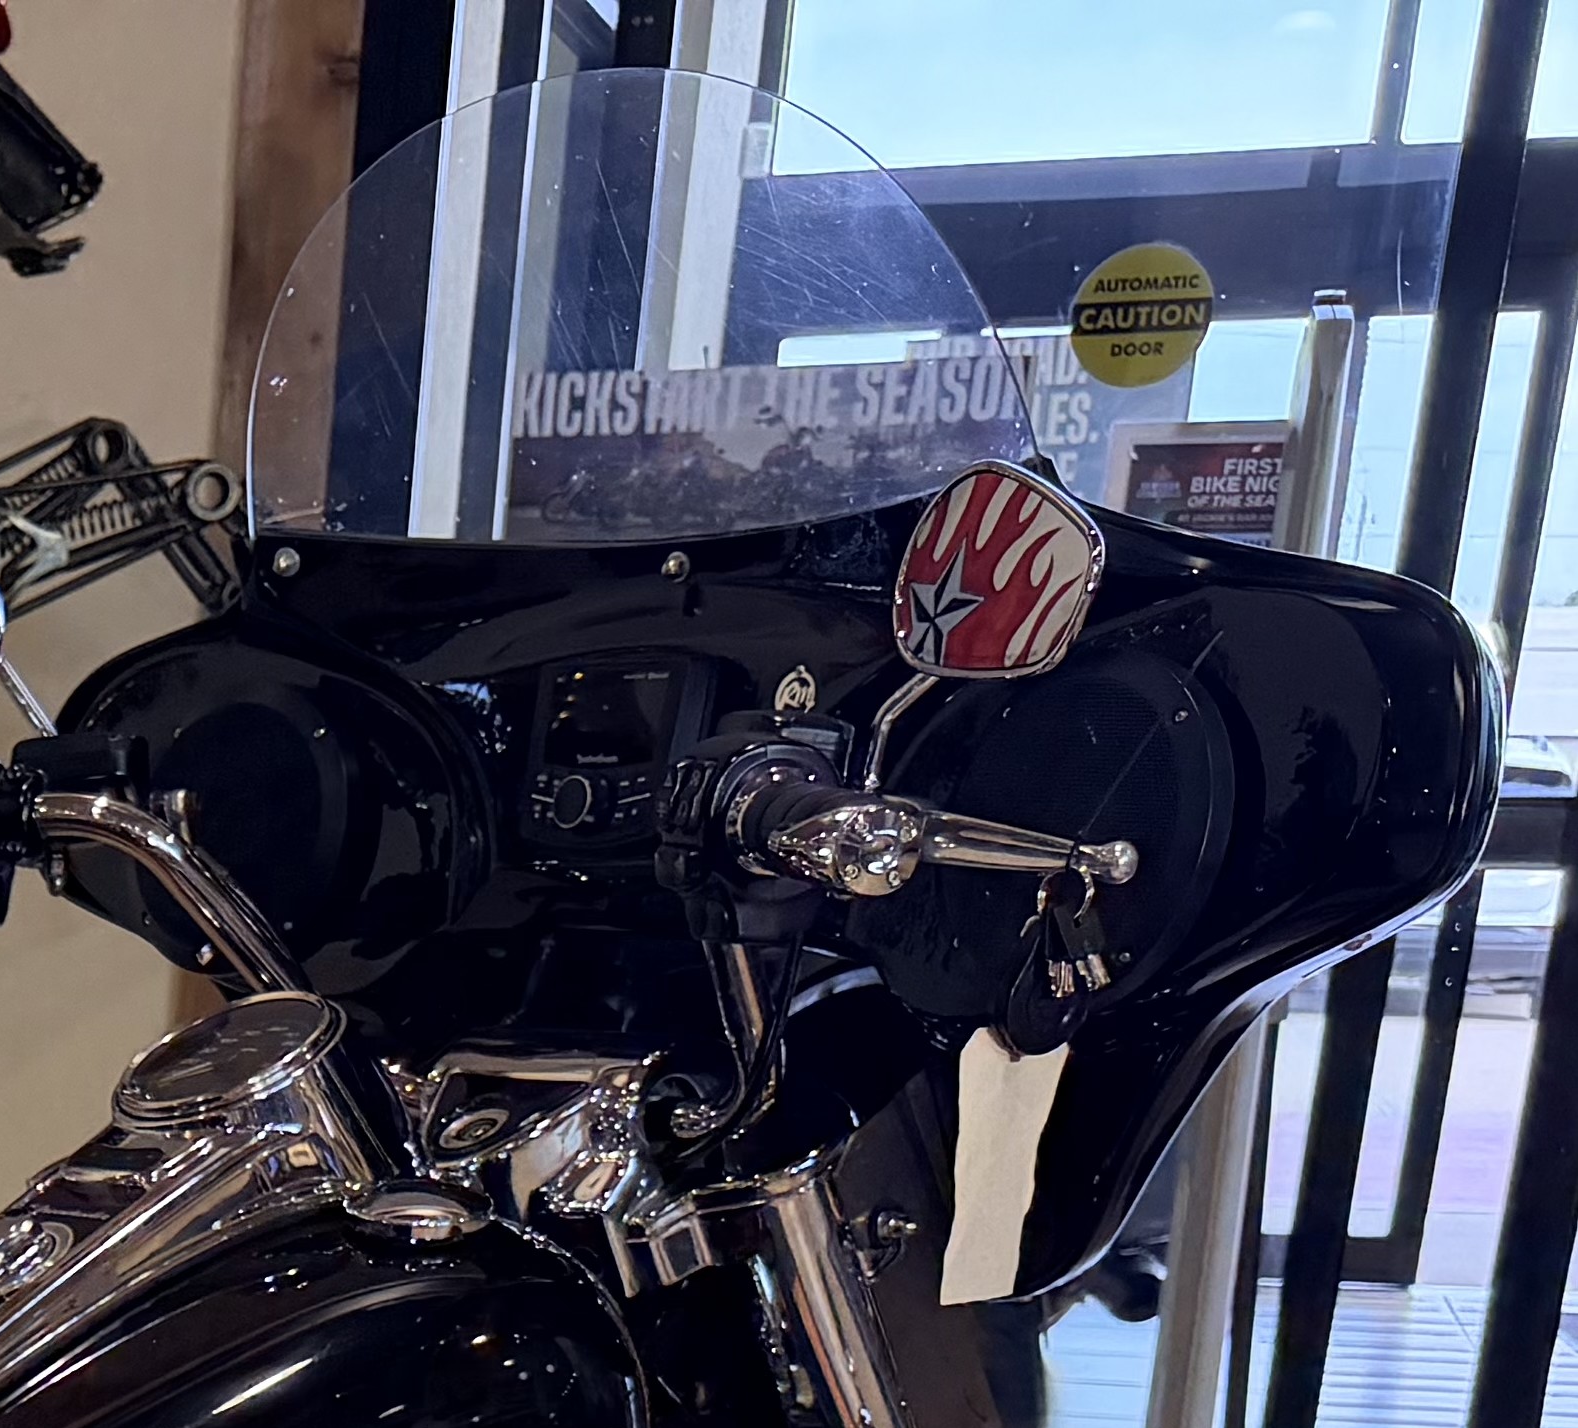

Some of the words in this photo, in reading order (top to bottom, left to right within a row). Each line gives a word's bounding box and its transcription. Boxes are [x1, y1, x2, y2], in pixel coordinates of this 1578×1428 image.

[1095, 274, 1200, 293] AUTOMATIC
[1079, 303, 1206, 331] CAUTION
[1110, 342, 1164, 357] DOOR
[512, 367, 746, 438] KICKSTART
[758, 364, 840, 432] THE
[1223, 457, 1283, 476] FIRST
[1190, 476, 1243, 494] BIKE
[1187, 496, 1210, 508] OF
[1212, 495, 1243, 507] THE
